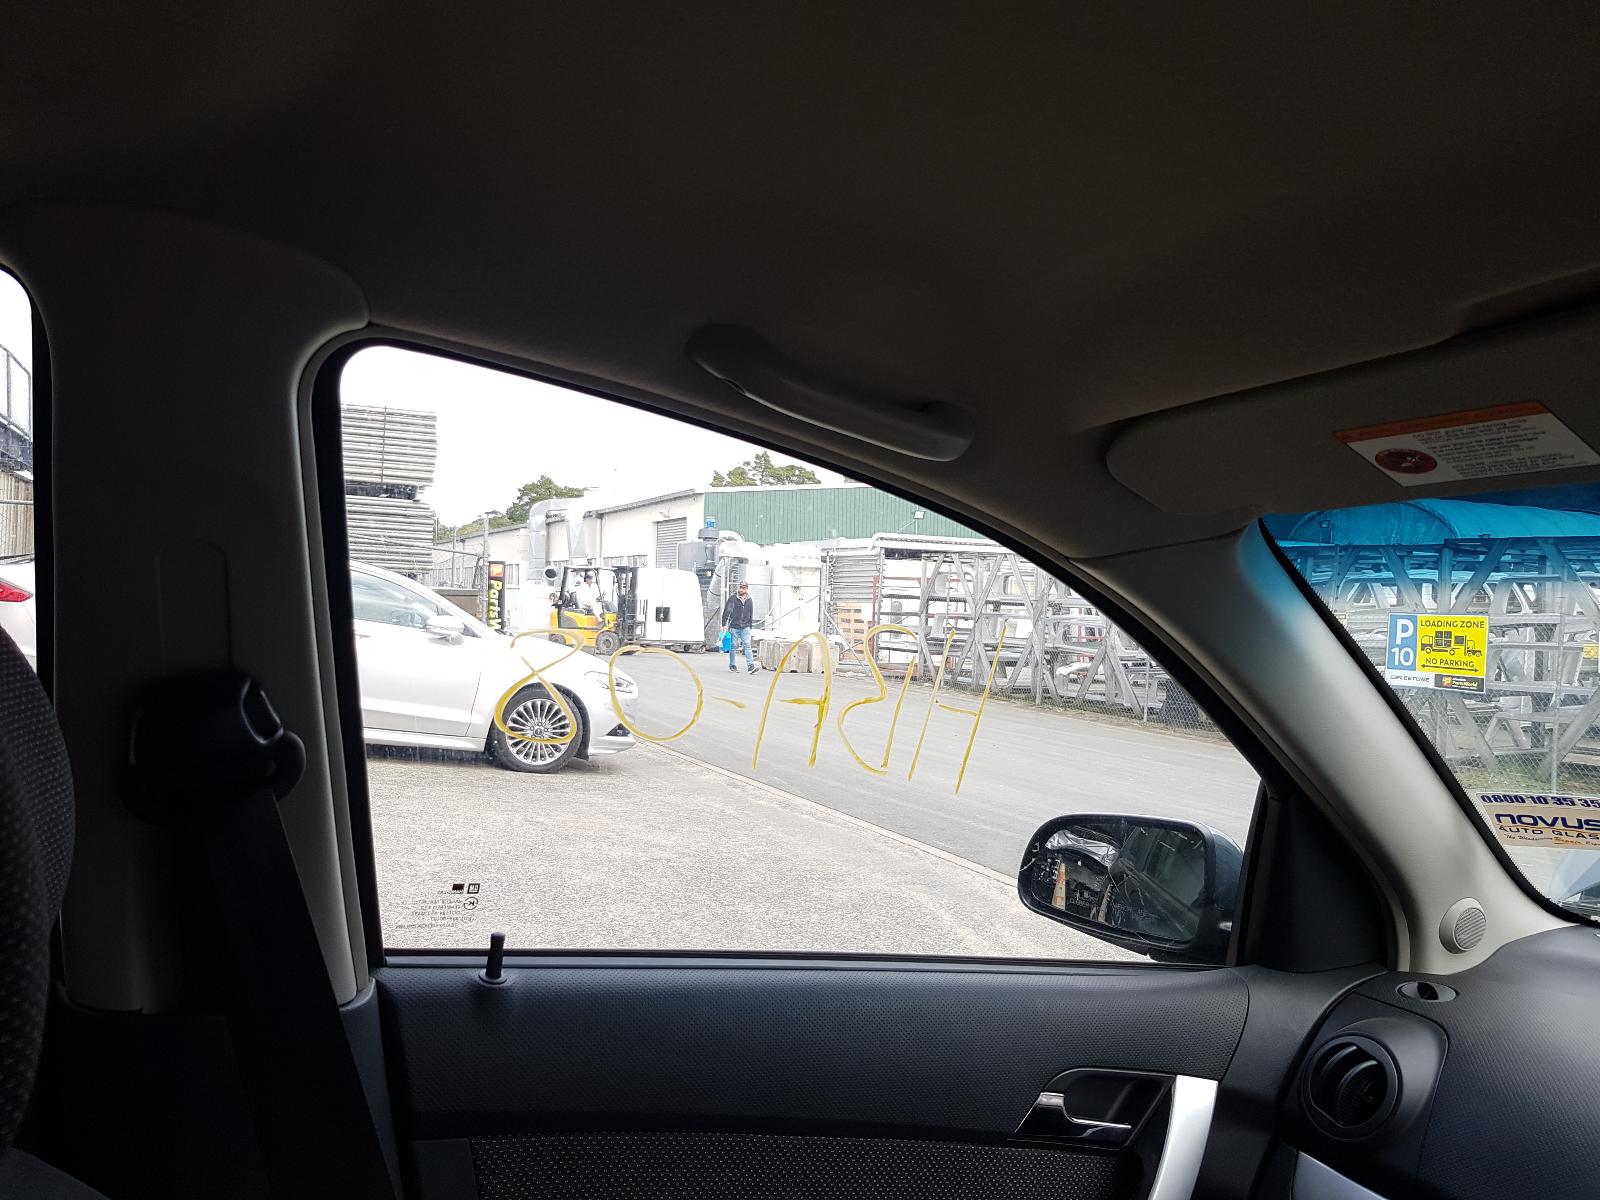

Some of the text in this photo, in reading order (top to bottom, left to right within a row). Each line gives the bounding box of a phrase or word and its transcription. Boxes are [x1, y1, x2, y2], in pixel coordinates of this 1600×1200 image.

[1420, 619, 1485, 629] LOADING ZONE
[1395, 618, 1414, 645] P
[1391, 647, 1415, 666] 10
[1425, 657, 1475, 668] NO PARKING
[1480, 794, 1527, 804] 0800
[1528, 795, 1549, 805] 10
[1550, 796, 1577, 806] 35
[1498, 826, 1544, 835] AUTO
